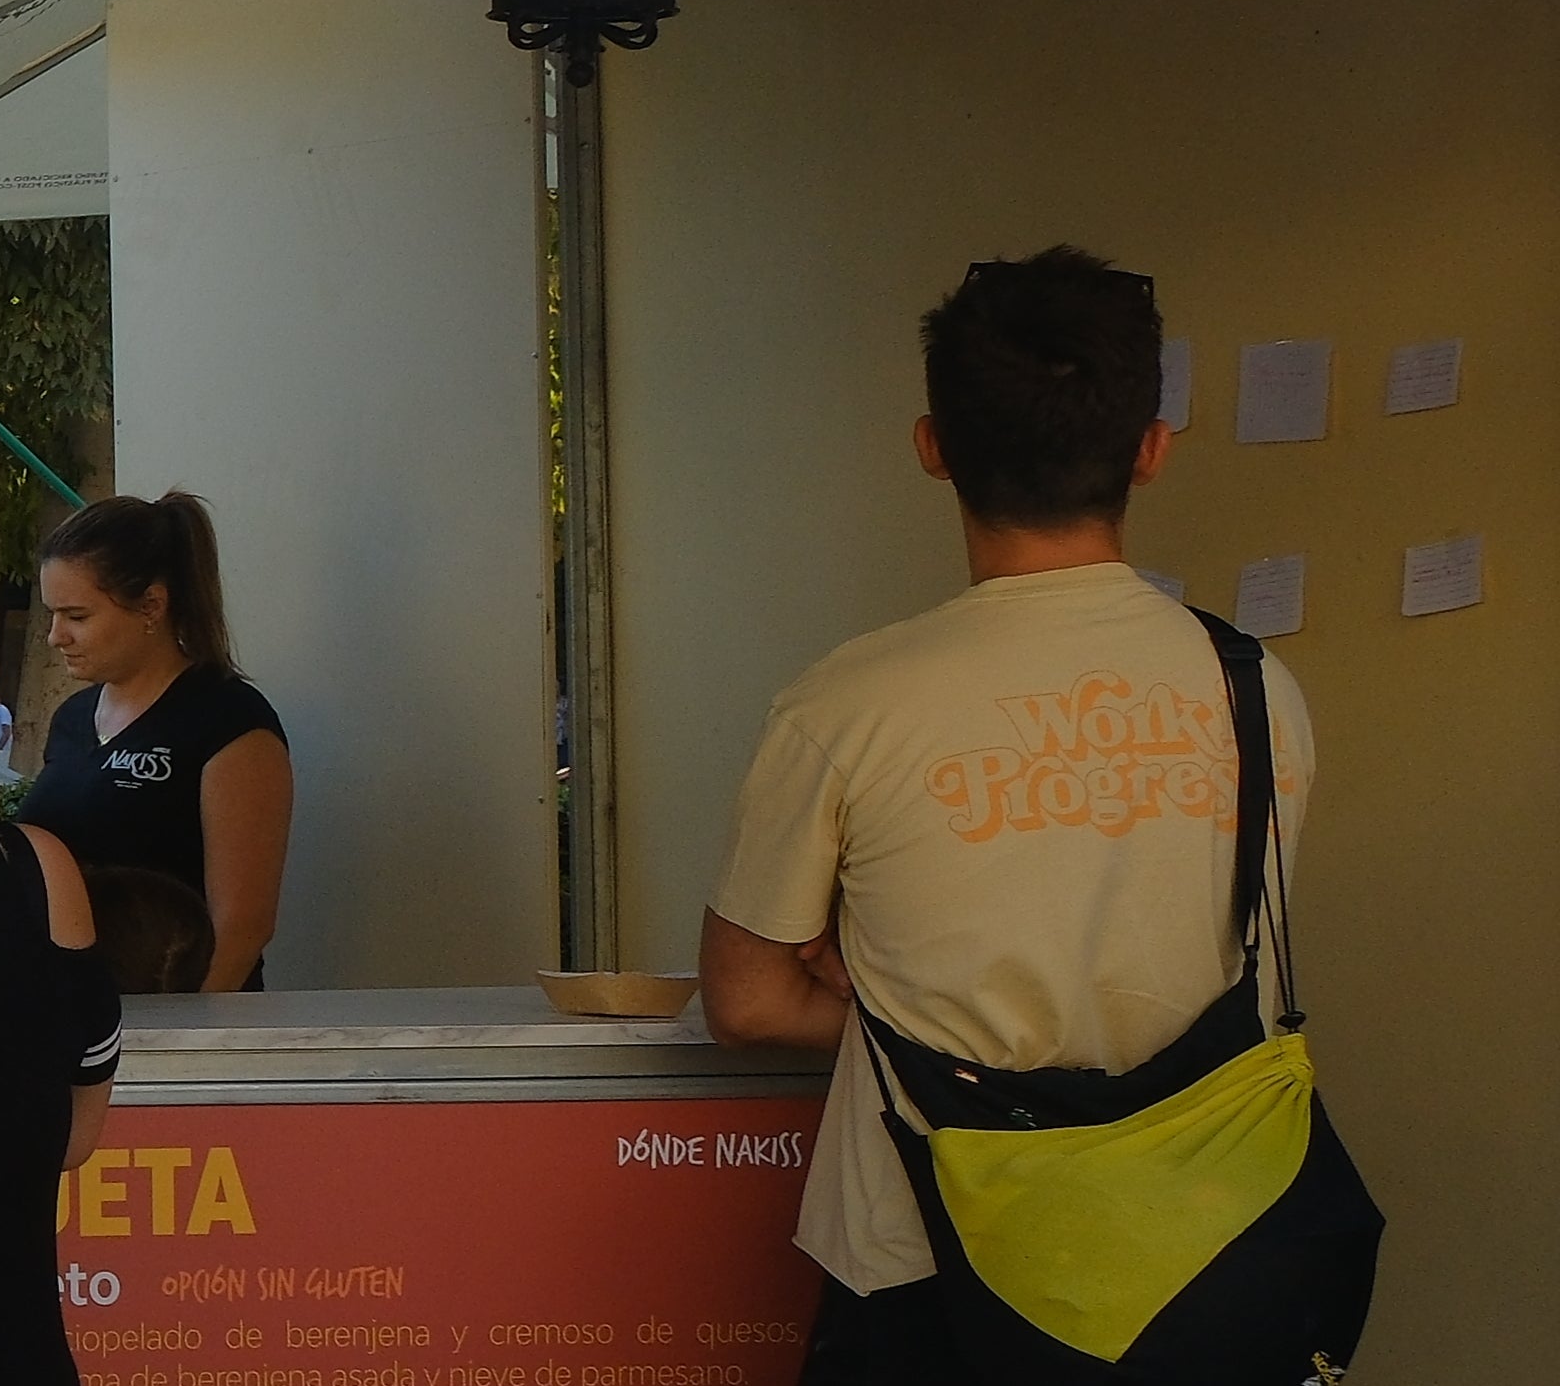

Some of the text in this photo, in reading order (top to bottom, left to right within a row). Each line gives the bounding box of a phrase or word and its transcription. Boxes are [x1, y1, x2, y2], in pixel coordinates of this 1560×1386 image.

[715, 1131, 802, 1169] NAKISS
[256, 1266, 295, 1302] SIN
[303, 1265, 404, 1301] GLUTEN
[225, 1319, 263, 1350] de
[285, 1317, 431, 1356] berenjena
[449, 1325, 470, 1355] y
[488, 1322, 614, 1347] cremoso
[636, 1314, 674, 1346] de
[694, 1320, 805, 1351] quesos,
